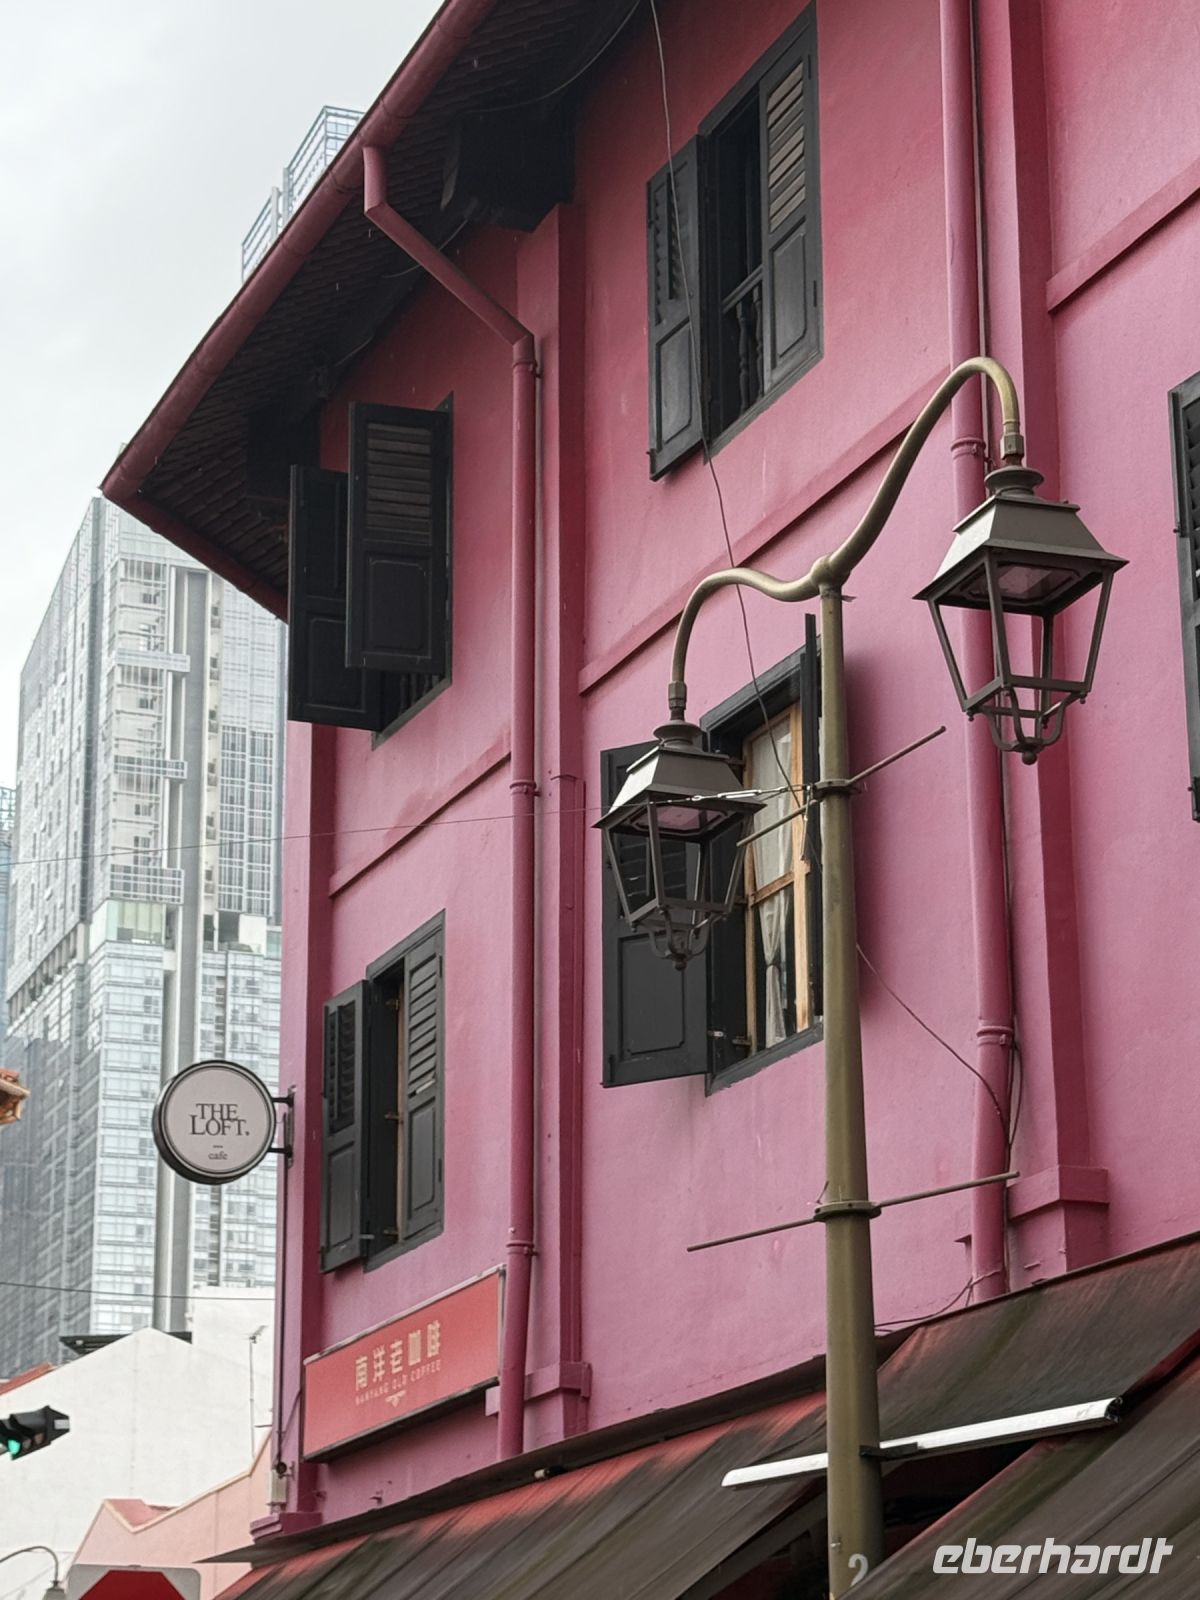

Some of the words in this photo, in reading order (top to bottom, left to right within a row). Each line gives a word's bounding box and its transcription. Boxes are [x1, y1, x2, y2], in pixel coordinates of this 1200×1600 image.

[196, 1103, 238, 1120] THE
[189, 1115, 250, 1136] LOFT.
[208, 1151, 228, 1160] cafe
[392, 1374, 407, 1390] OLD
[411, 1359, 441, 1382] COFFEE
